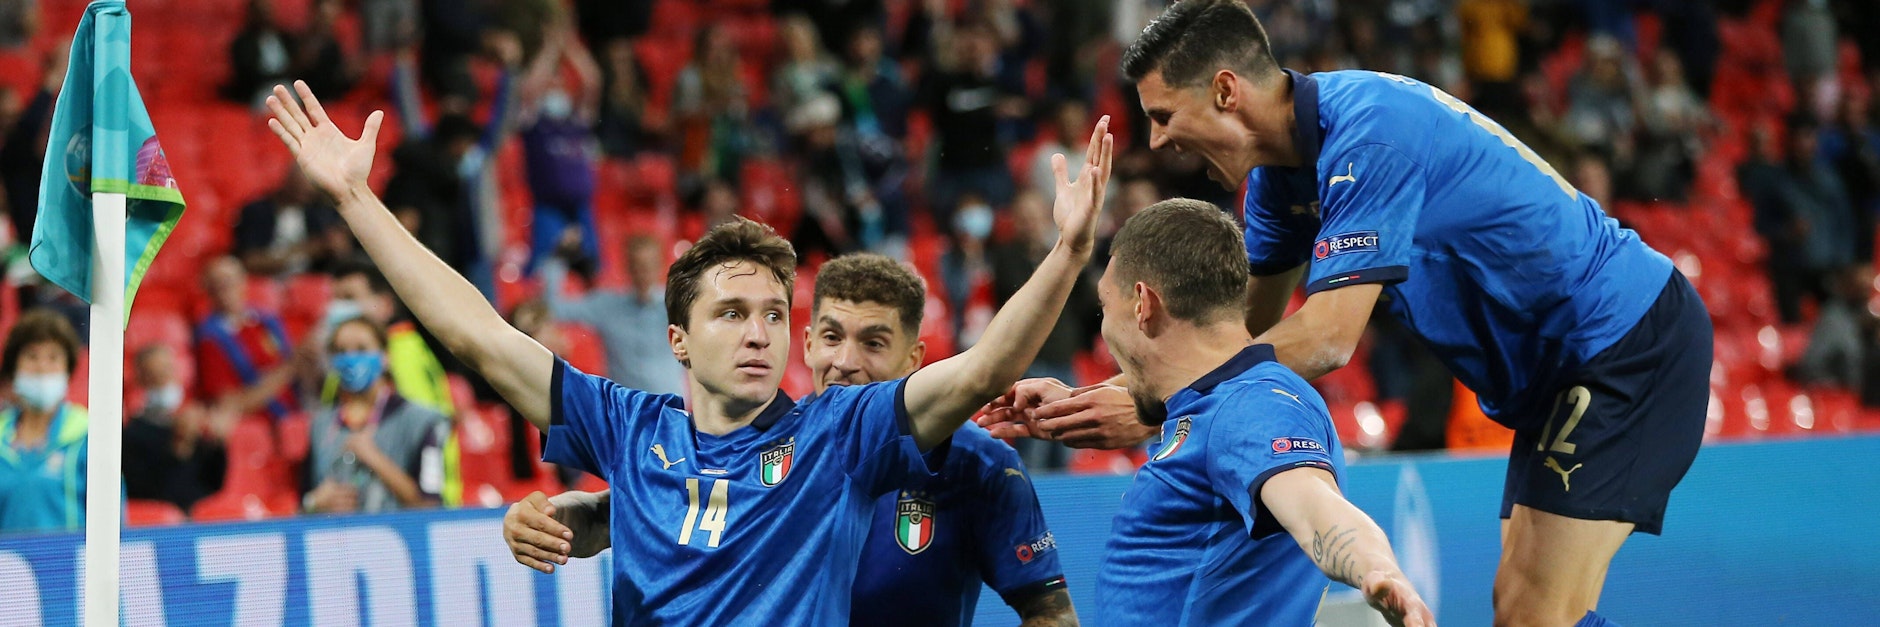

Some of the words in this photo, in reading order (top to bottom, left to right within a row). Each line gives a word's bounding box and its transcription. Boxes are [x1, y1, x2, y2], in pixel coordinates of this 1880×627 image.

[1330, 236, 1378, 251] RESPECT
[1537, 386, 1591, 454] 12
[764, 446, 792, 462] ITALIA
[678, 478, 729, 547] 14
[901, 503, 932, 513] ITALIA
